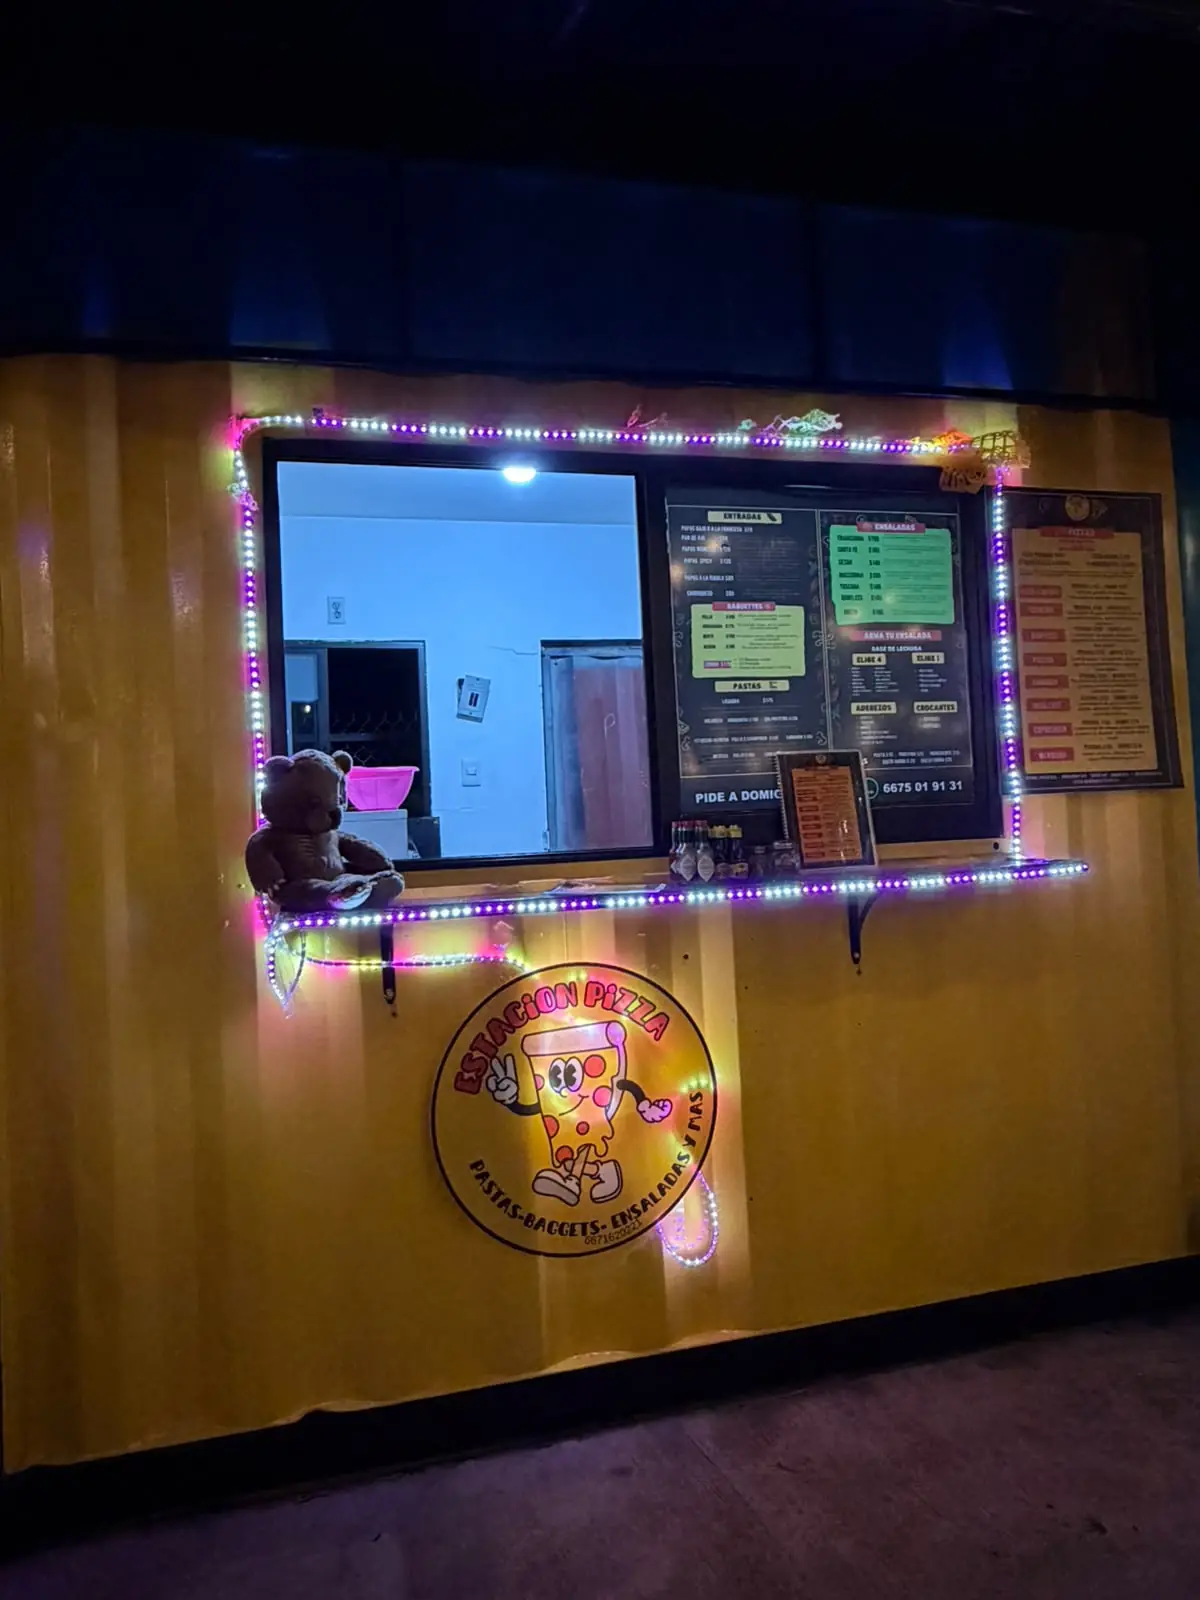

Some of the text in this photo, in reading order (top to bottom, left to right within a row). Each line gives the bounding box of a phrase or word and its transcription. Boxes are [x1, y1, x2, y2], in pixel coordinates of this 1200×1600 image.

[723, 511, 762, 521] ENTRADAS
[874, 523, 916, 531] ENSALADAS
[896, 630, 932, 639] ENSALADA
[856, 704, 892, 712] ADEREZOS
[916, 704, 956, 712] CROCANTES
[883, 780, 963, 794] 6675 01 91 31
[695, 791, 725, 804] PIDE
[728, 790, 739, 802] A
[688, 1091, 704, 1132] MAS
[682, 1134, 697, 1149] Y
[610, 1151, 692, 1230] ENSALADAS
